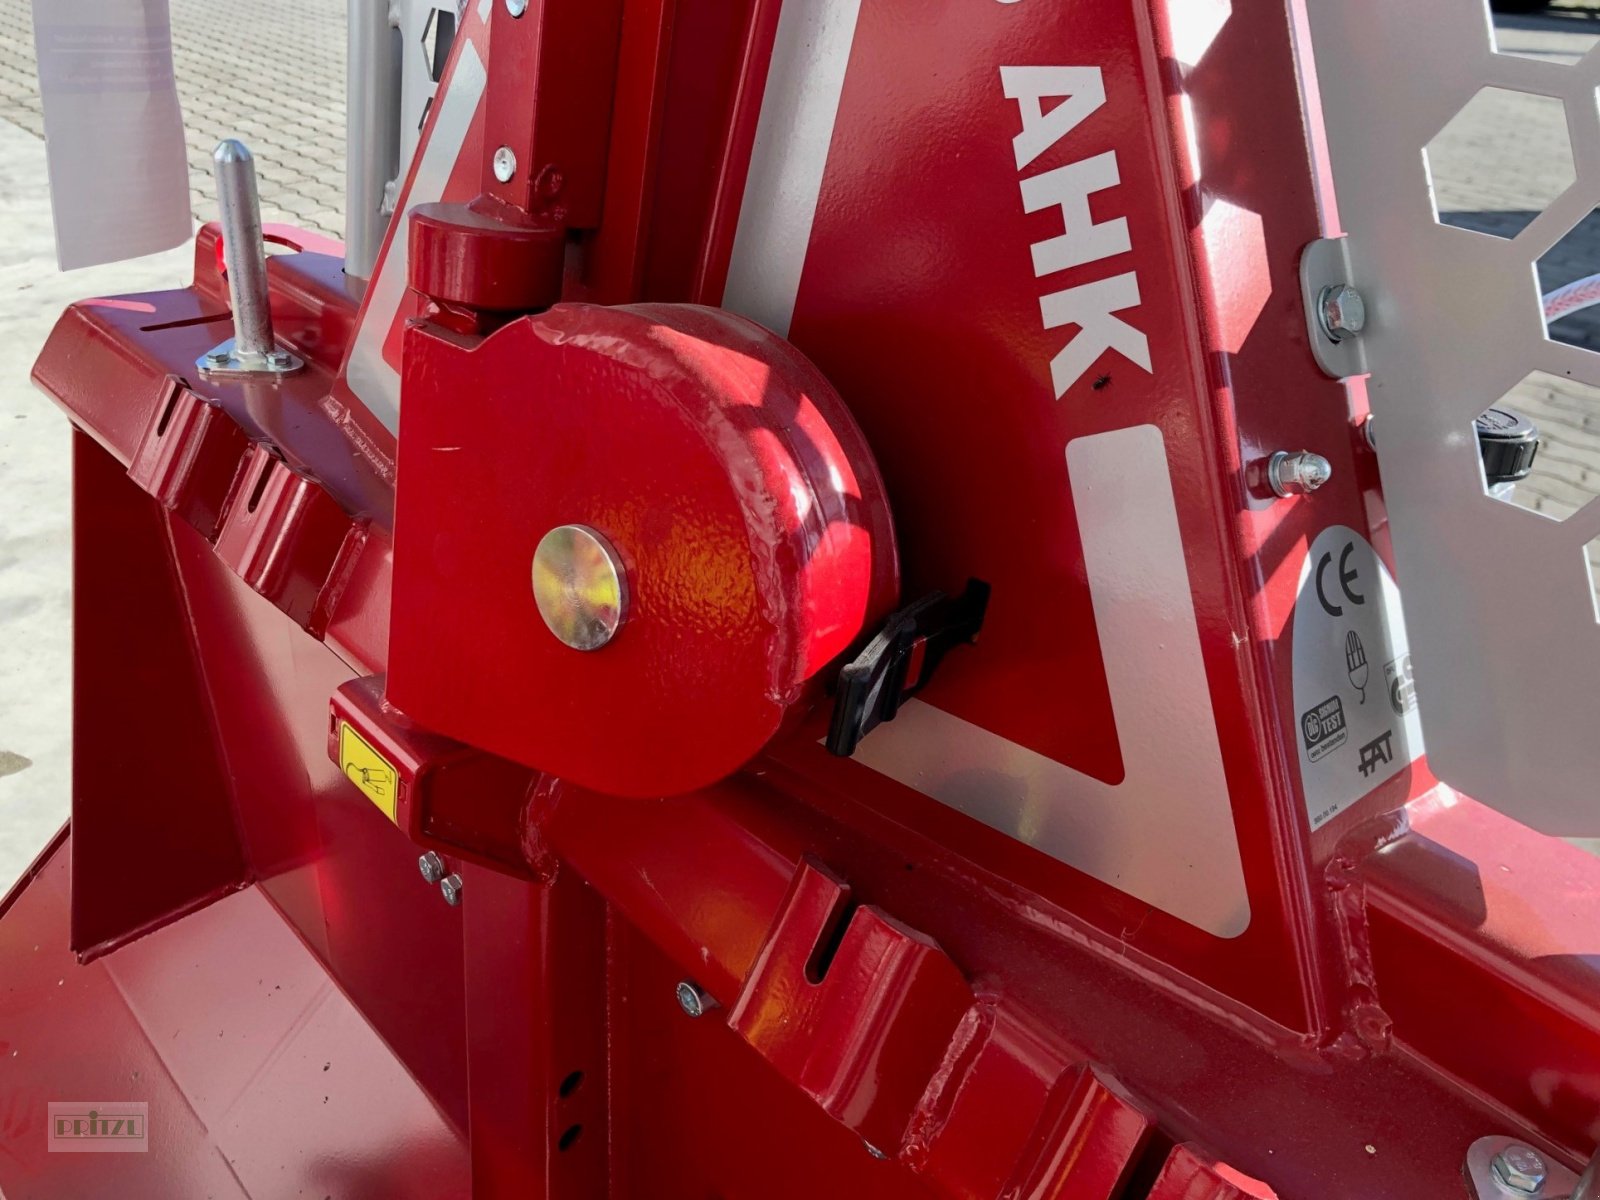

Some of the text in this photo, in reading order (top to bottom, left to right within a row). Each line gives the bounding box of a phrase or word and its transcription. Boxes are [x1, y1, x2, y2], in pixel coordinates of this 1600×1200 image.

[999, 65, 1153, 401] AHK
[1315, 541, 1365, 617] CE
[1321, 711, 1342, 735] TEST
[1358, 729, 1393, 778] FAT
